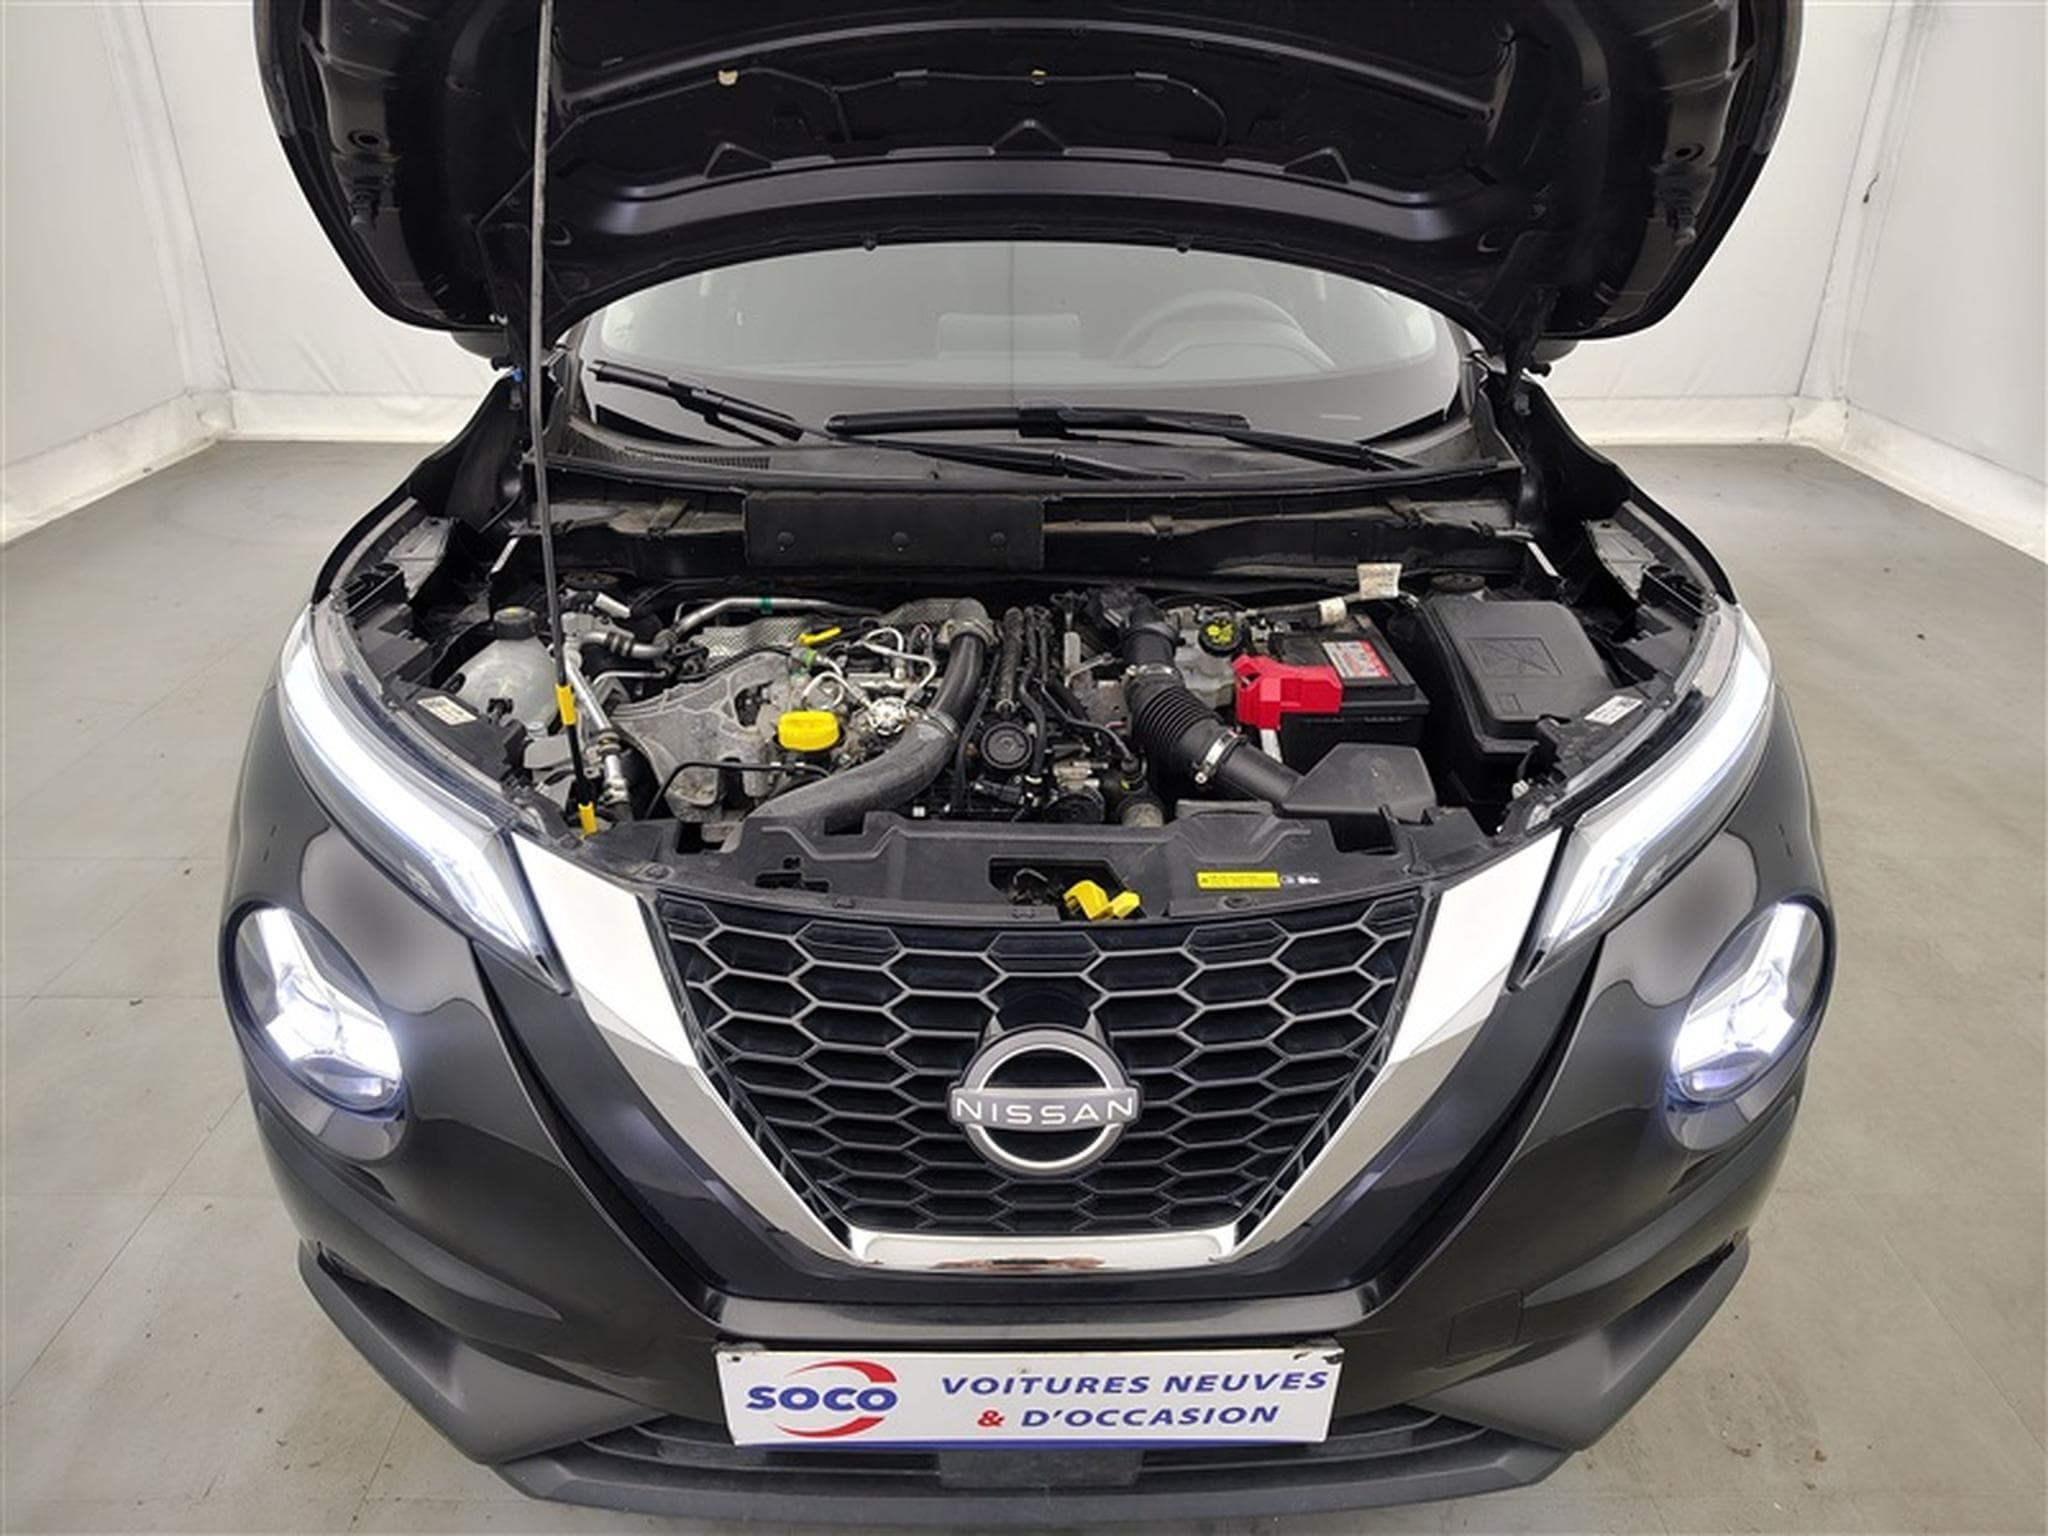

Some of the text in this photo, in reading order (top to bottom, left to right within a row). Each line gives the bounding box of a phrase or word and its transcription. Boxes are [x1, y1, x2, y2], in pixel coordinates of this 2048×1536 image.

[956, 1096, 1133, 1125] NISSAN
[942, 1371, 1329, 1395] VOITURES NEUVES
[746, 1386, 898, 1412] SOCO
[977, 1406, 1280, 1428] & D'OCCASION
